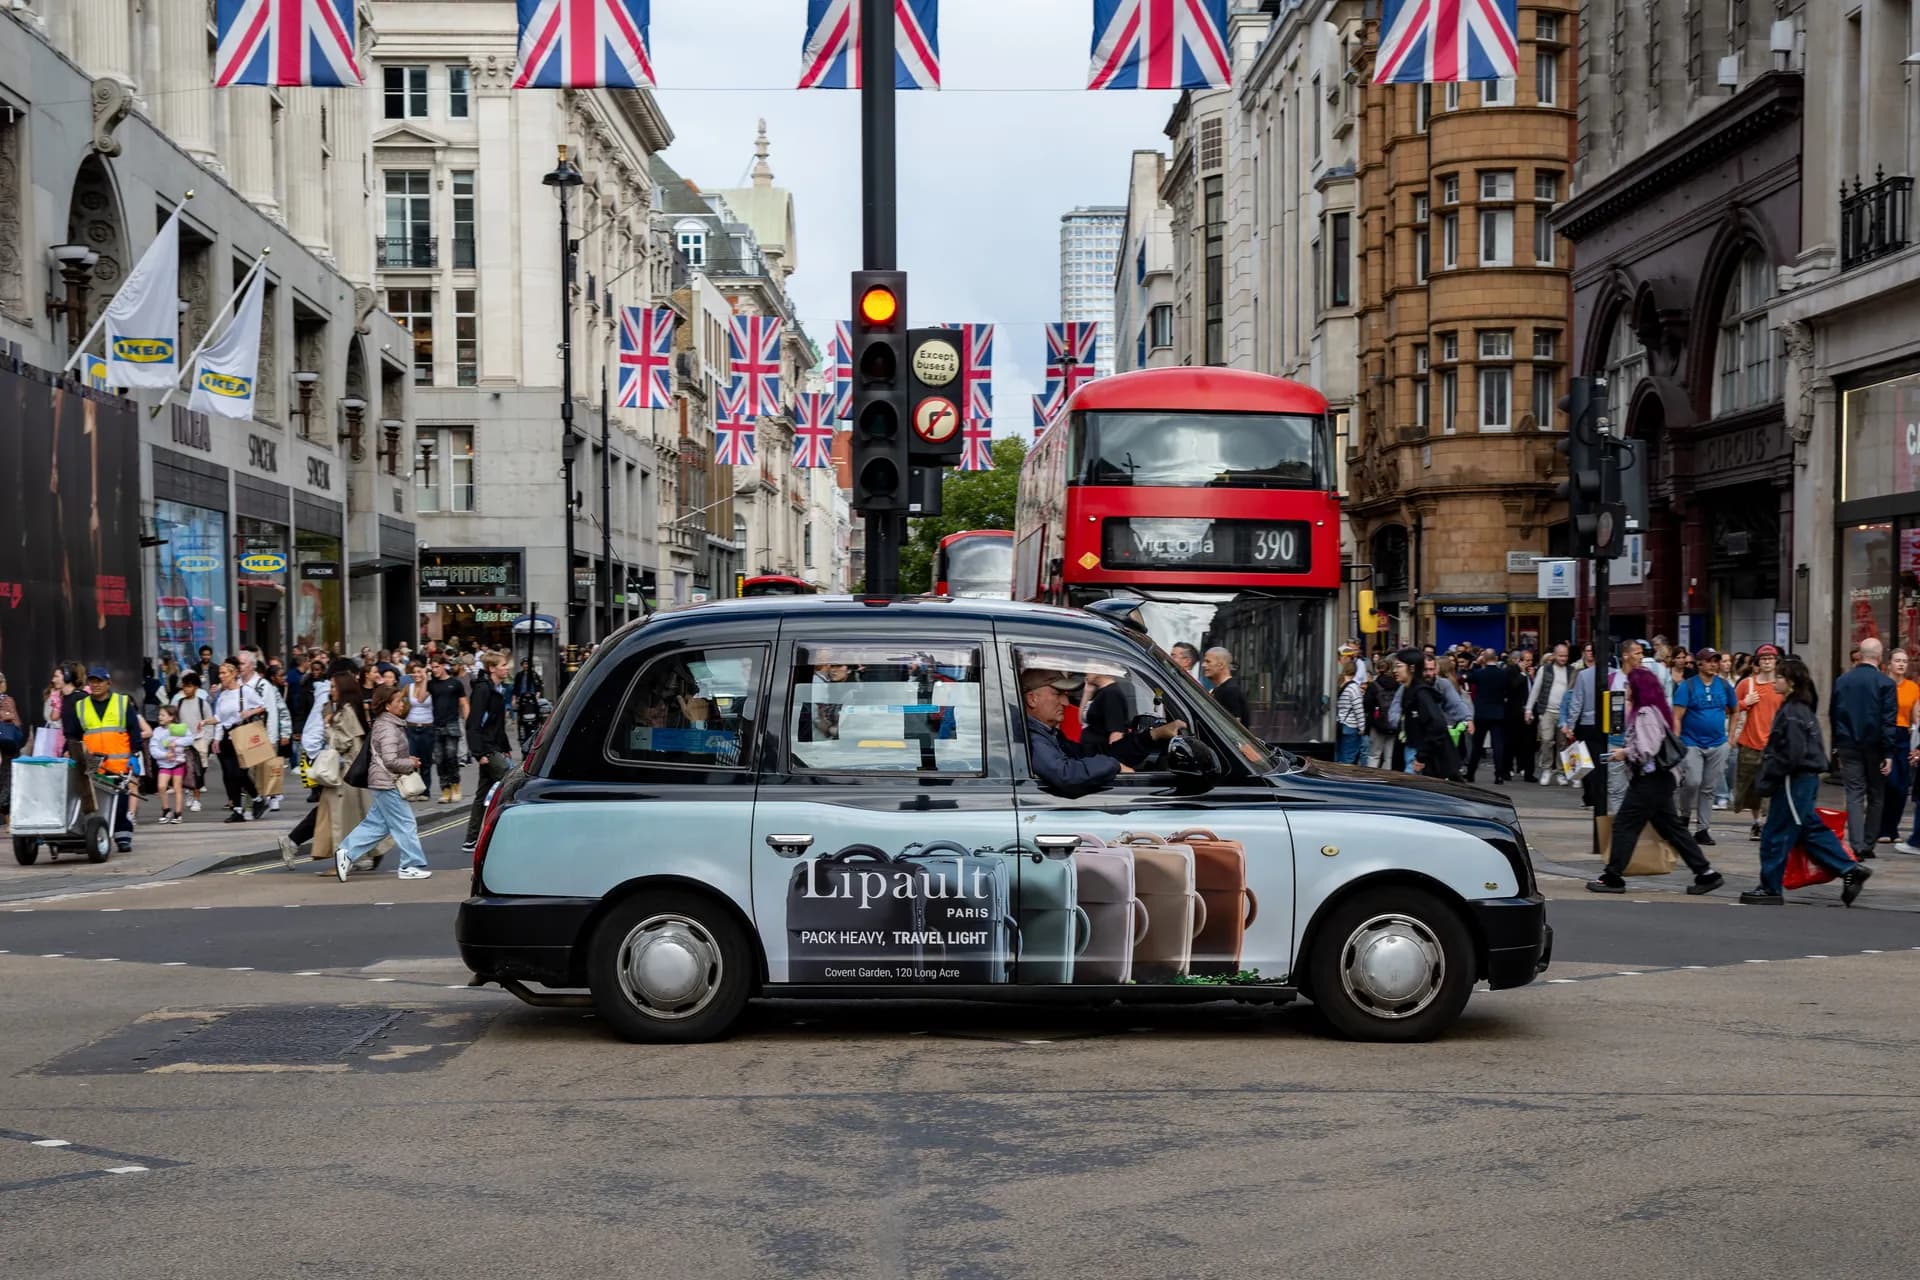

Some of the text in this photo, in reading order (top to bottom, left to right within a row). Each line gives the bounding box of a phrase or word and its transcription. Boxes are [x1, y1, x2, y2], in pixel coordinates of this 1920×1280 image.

[117, 343, 168, 356] IKEA
[920, 350, 954, 362] Except
[916, 360, 955, 371] buses &
[923, 372, 947, 381] taxis
[205, 376, 247, 393] IKEA
[171, 403, 211, 452] IKEA
[1132, 530, 1294, 560] Victoria 390
[245, 559, 281, 567] IKEA
[1458, 605, 1489, 613] MACHINE
[801, 857, 989, 909] Lipault
[946, 908, 989, 918] PARIS
[801, 931, 988, 946] PACK HEAVY, TRAVEL LIGHT
[824, 967, 960, 979] Covent Garden, 120 Long Acre
